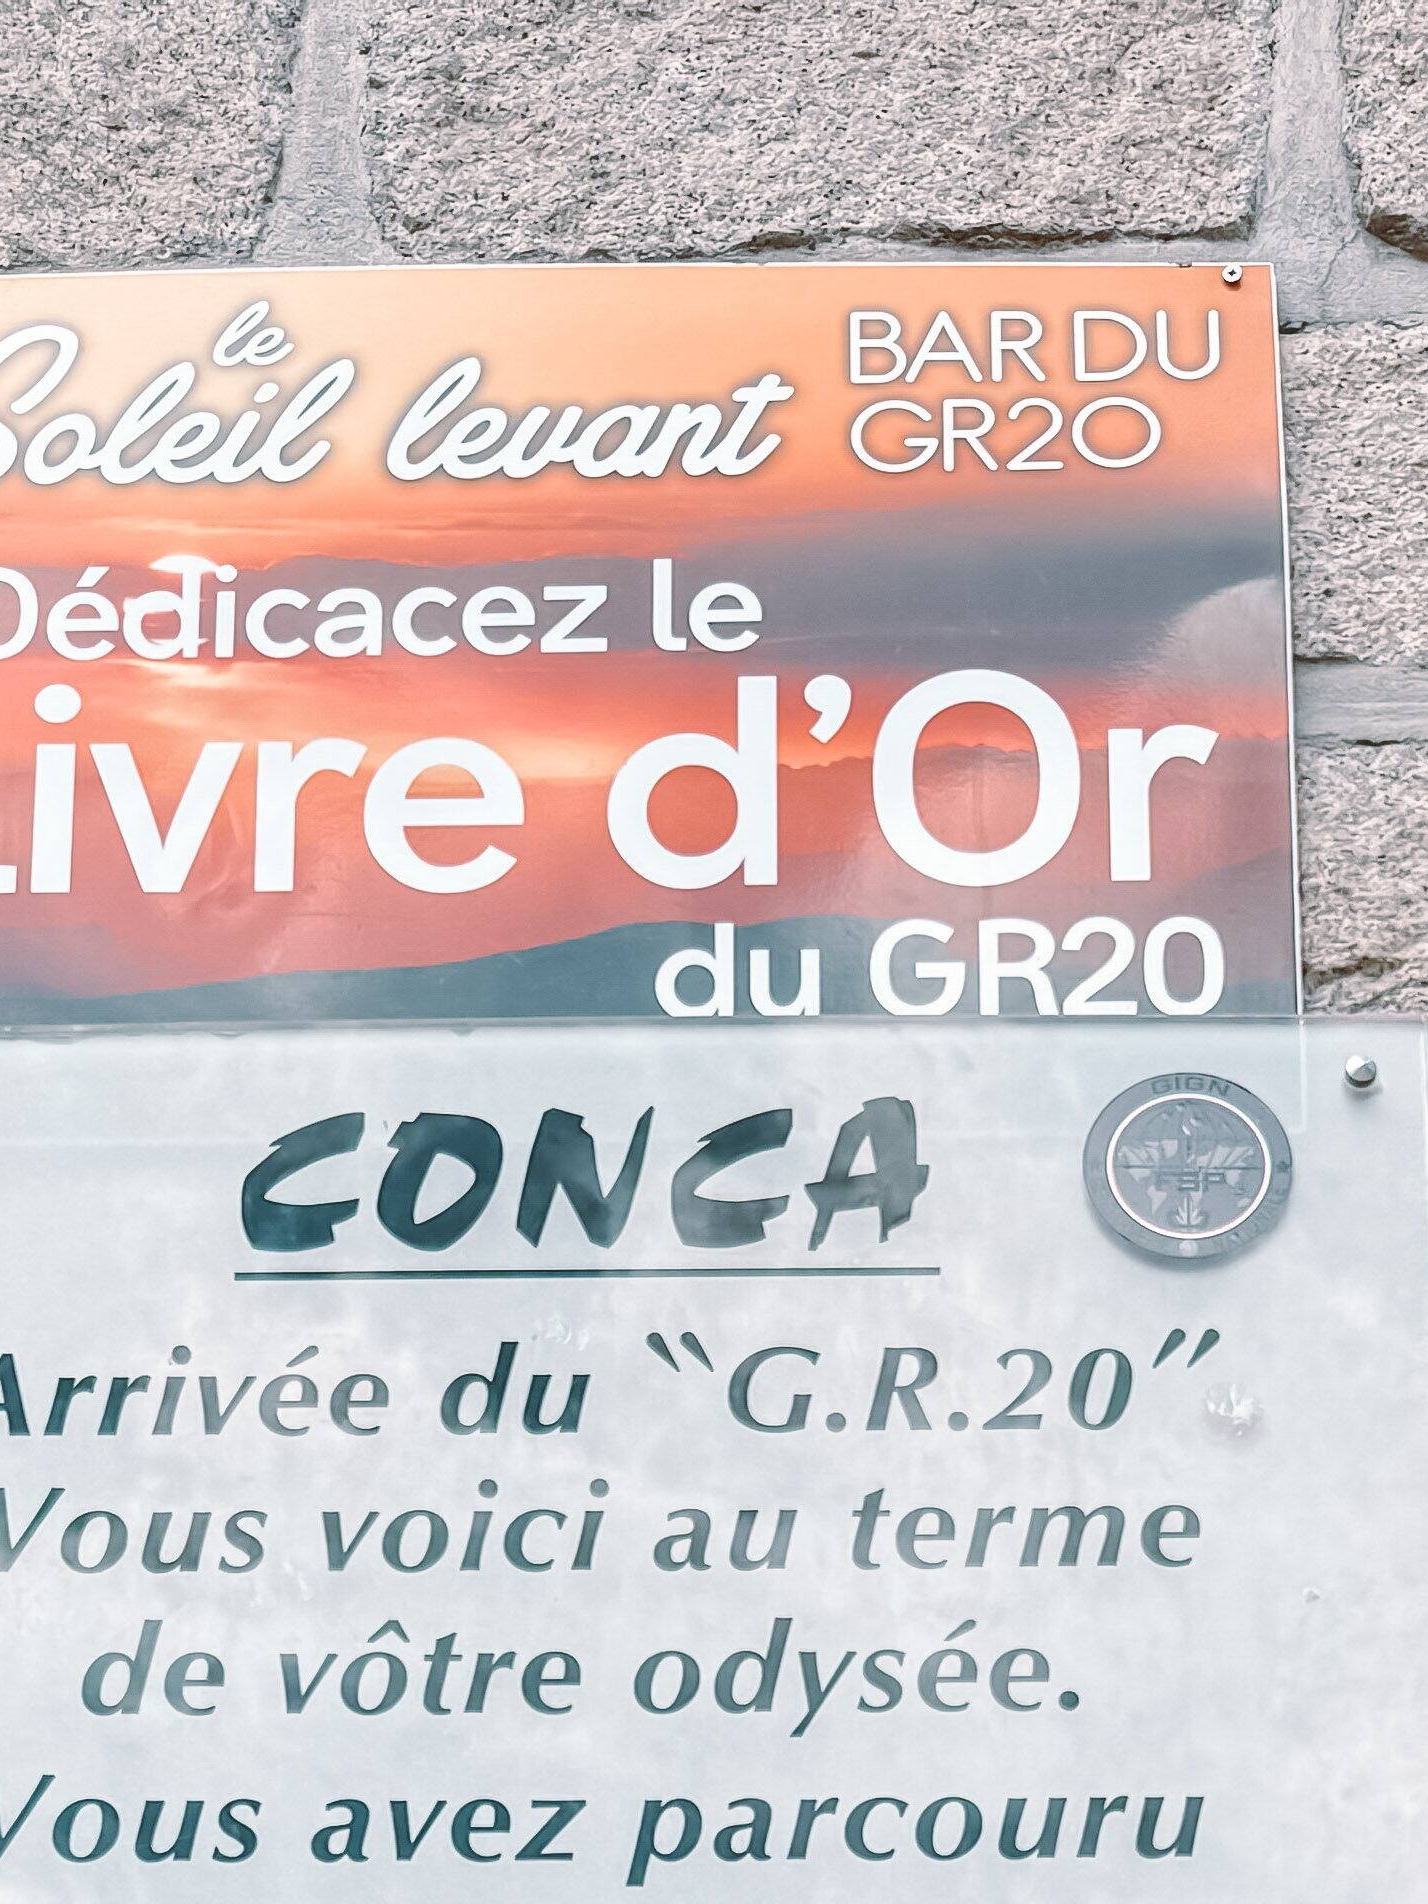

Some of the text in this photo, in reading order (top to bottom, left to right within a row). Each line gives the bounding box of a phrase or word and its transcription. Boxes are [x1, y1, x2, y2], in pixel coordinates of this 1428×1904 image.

[213, 301, 294, 366] le
[850, 310, 1219, 383] BAR DU
[387, 358, 794, 479] levant
[653, 559, 762, 651] le
[608, 669, 1218, 889] d’Or
[656, 917, 1224, 1016] du GR20
[1150, 1076, 1231, 1097] GIGN
[241, 1097, 929, 1252] CONCA
[441, 1341, 591, 1435] du
[323, 1479, 609, 1572] voici
[654, 1509, 797, 1571] au
[853, 1488, 1200, 1569] terme
[82, 1617, 1079, 1737] de vôtre odysée.
[311, 1799, 586, 1863] avez
[626, 1796, 1204, 1887] parcouru
